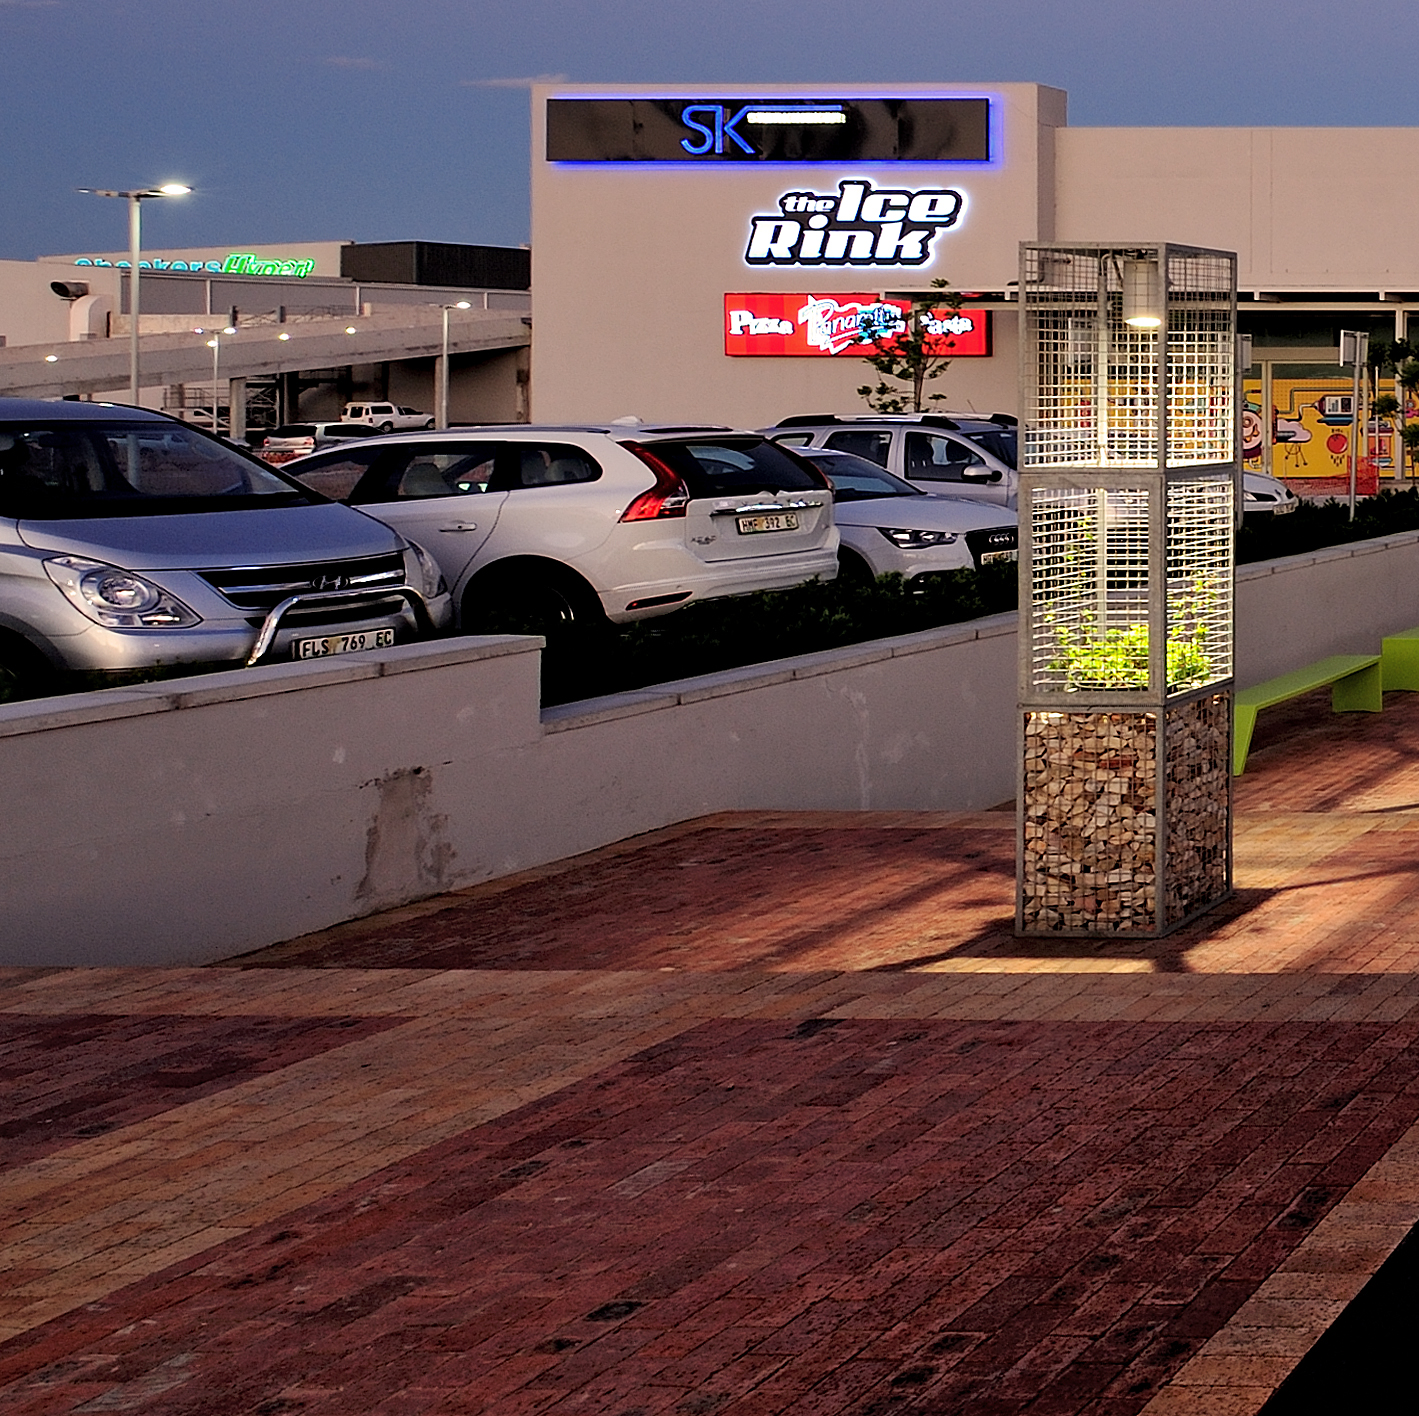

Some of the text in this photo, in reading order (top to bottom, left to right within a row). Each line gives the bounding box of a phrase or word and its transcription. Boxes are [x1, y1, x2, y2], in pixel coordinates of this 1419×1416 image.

[783, 183, 958, 223] the Ice
[748, 213, 931, 259] Rink
[729, 310, 794, 335] Pizza
[302, 639, 330, 658] FLS
[341, 635, 366, 652] 769
